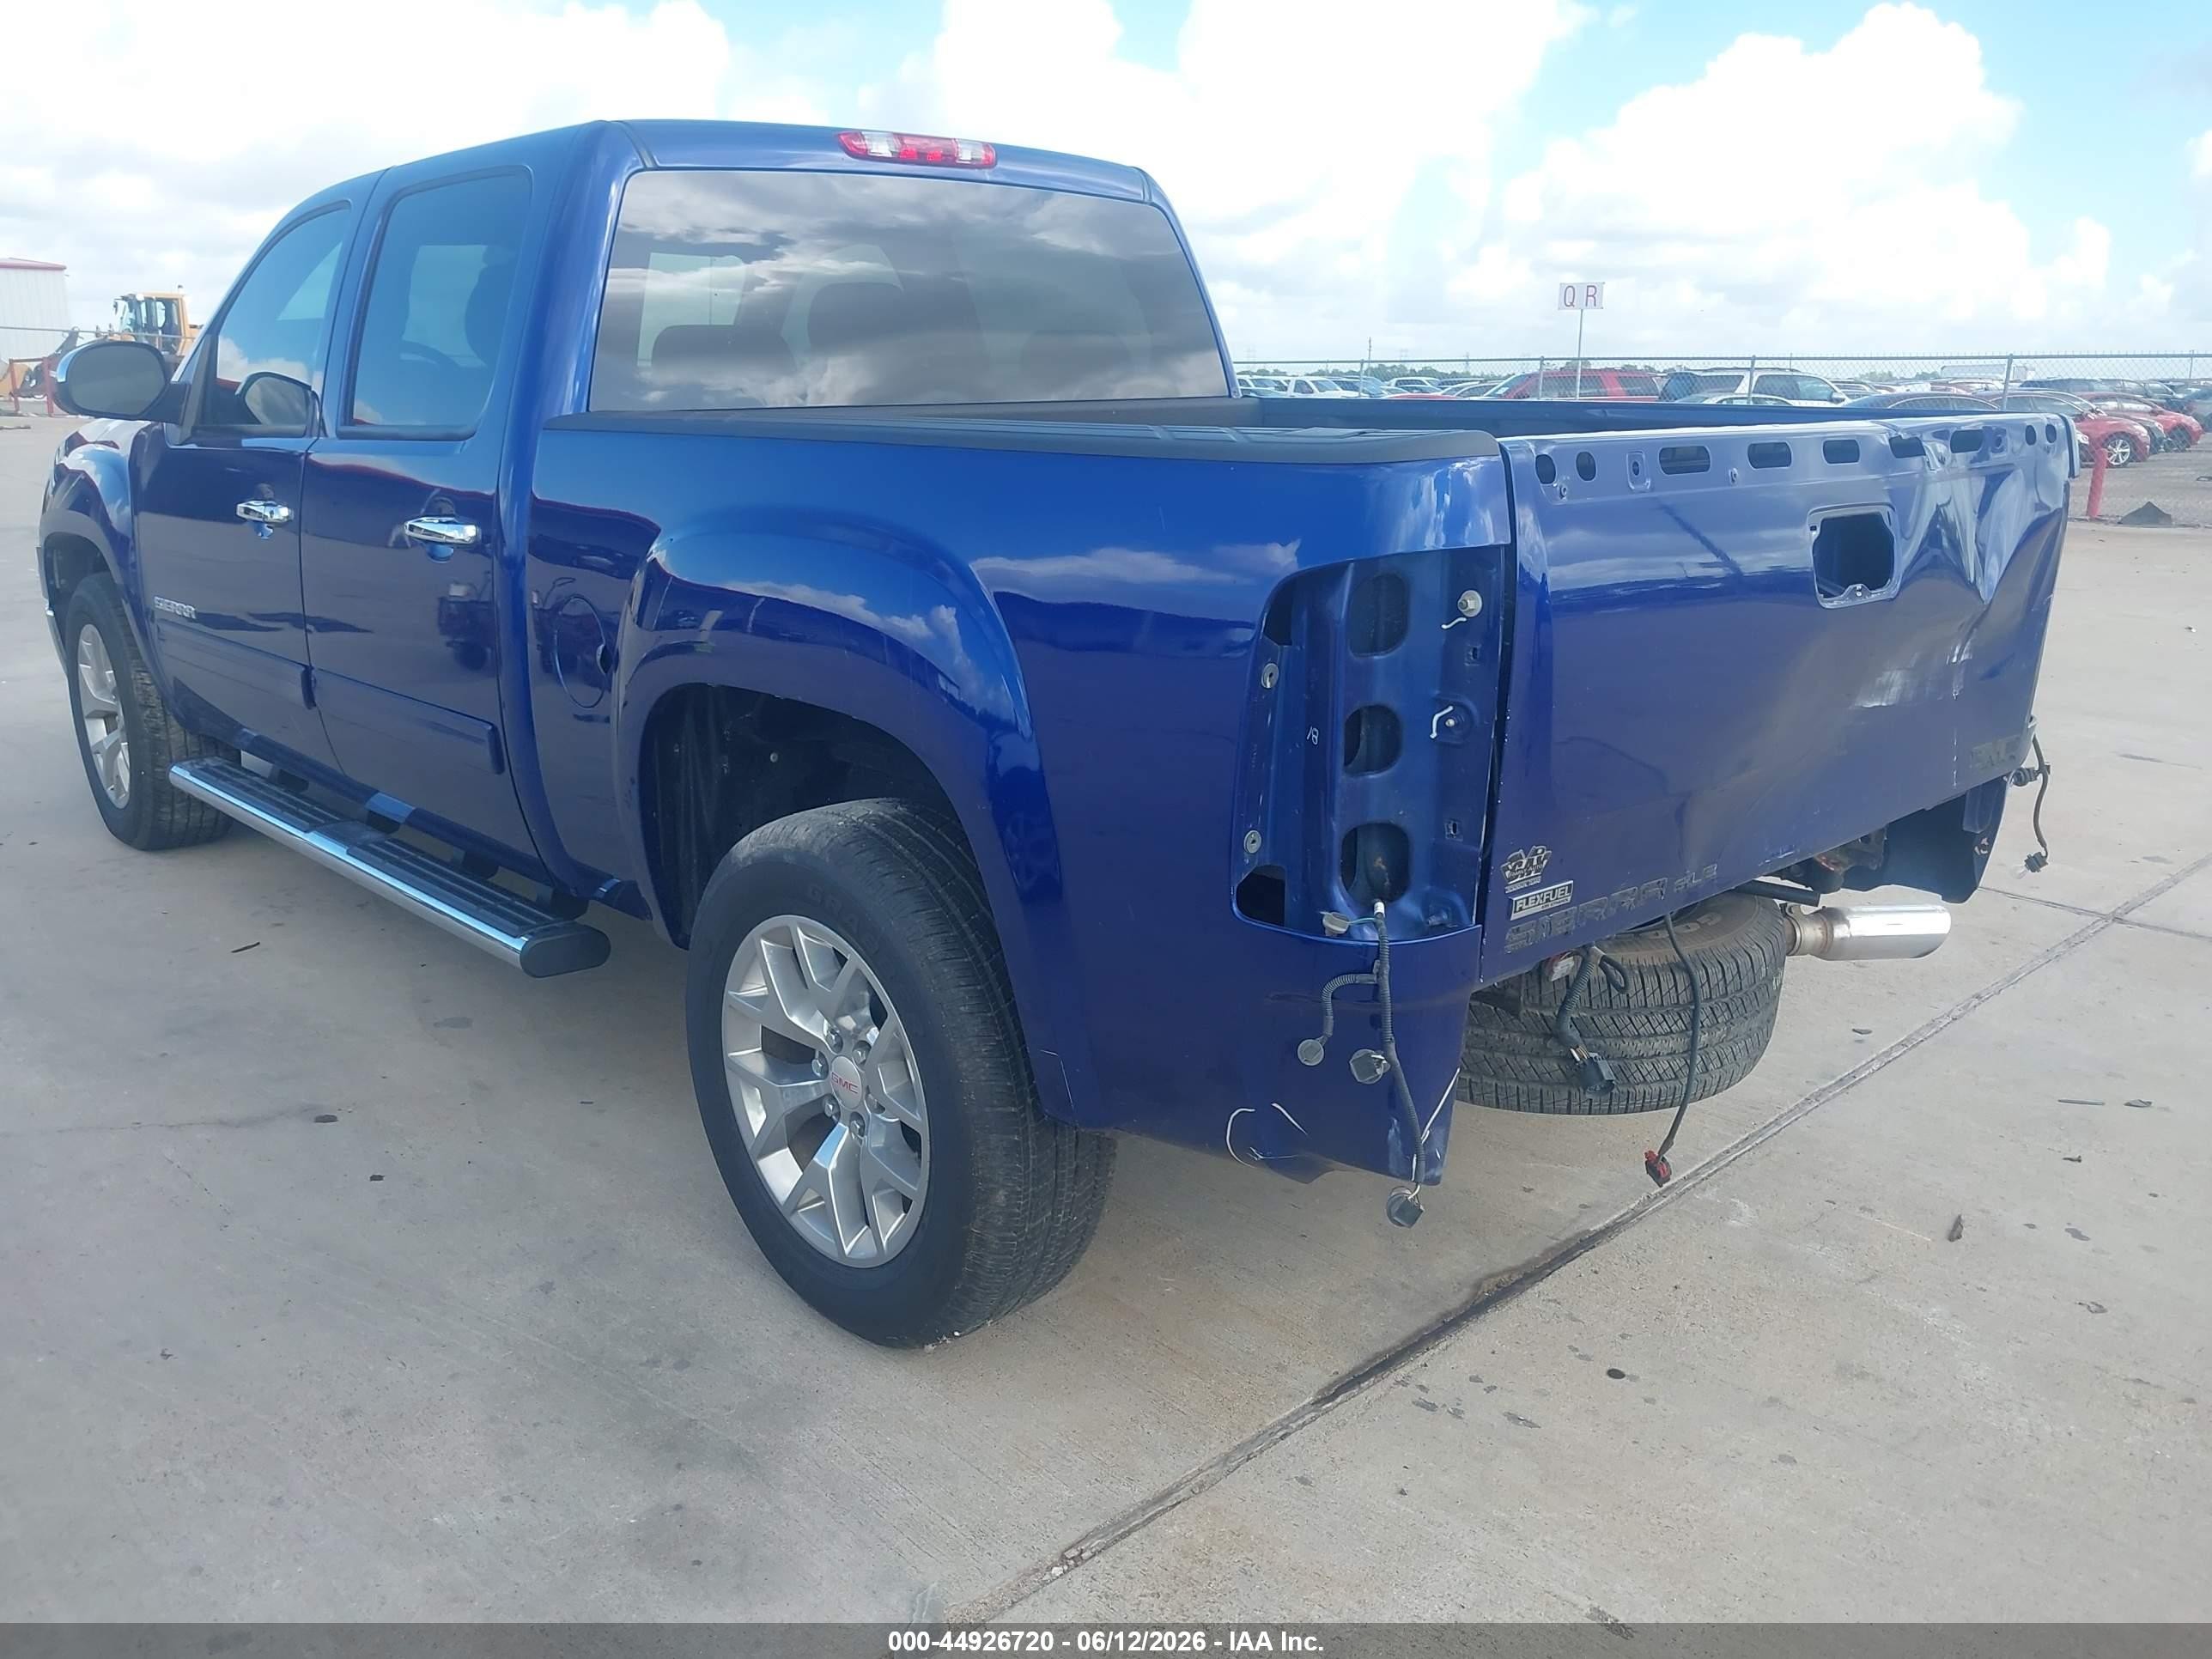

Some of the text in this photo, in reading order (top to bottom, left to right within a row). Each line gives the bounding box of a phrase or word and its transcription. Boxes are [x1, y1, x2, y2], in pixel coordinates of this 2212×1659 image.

[1564, 285, 1597, 307] Q R
[1516, 886, 1571, 912] FLEXFUEL
[831, 1072, 858, 1094] GMC
